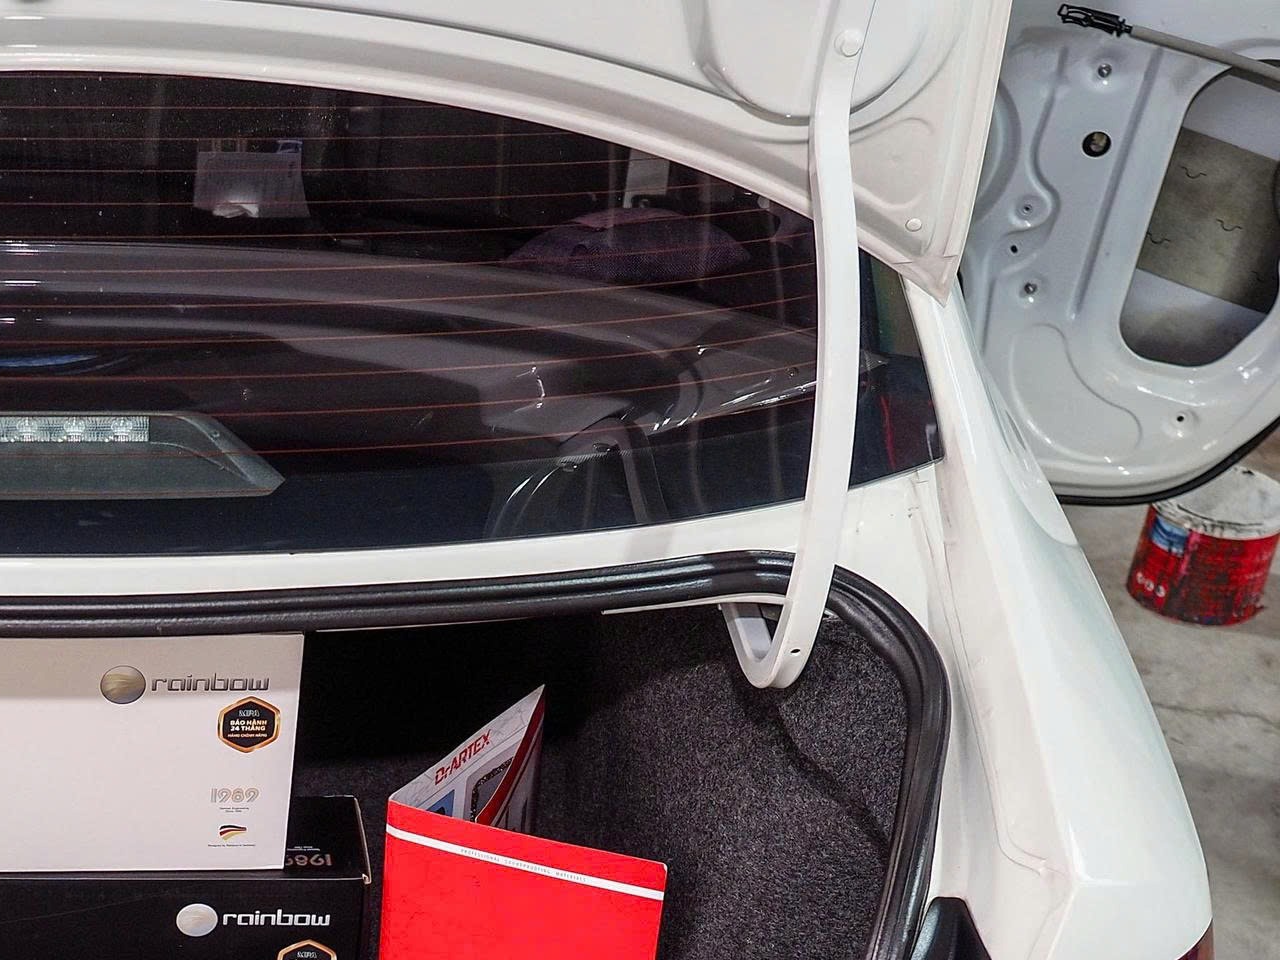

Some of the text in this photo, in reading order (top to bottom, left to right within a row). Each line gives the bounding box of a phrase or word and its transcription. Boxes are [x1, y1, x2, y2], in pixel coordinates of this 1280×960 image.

[151, 673, 269, 692] rainbow
[210, 787, 260, 803] 1989
[222, 909, 331, 926] rainbow
